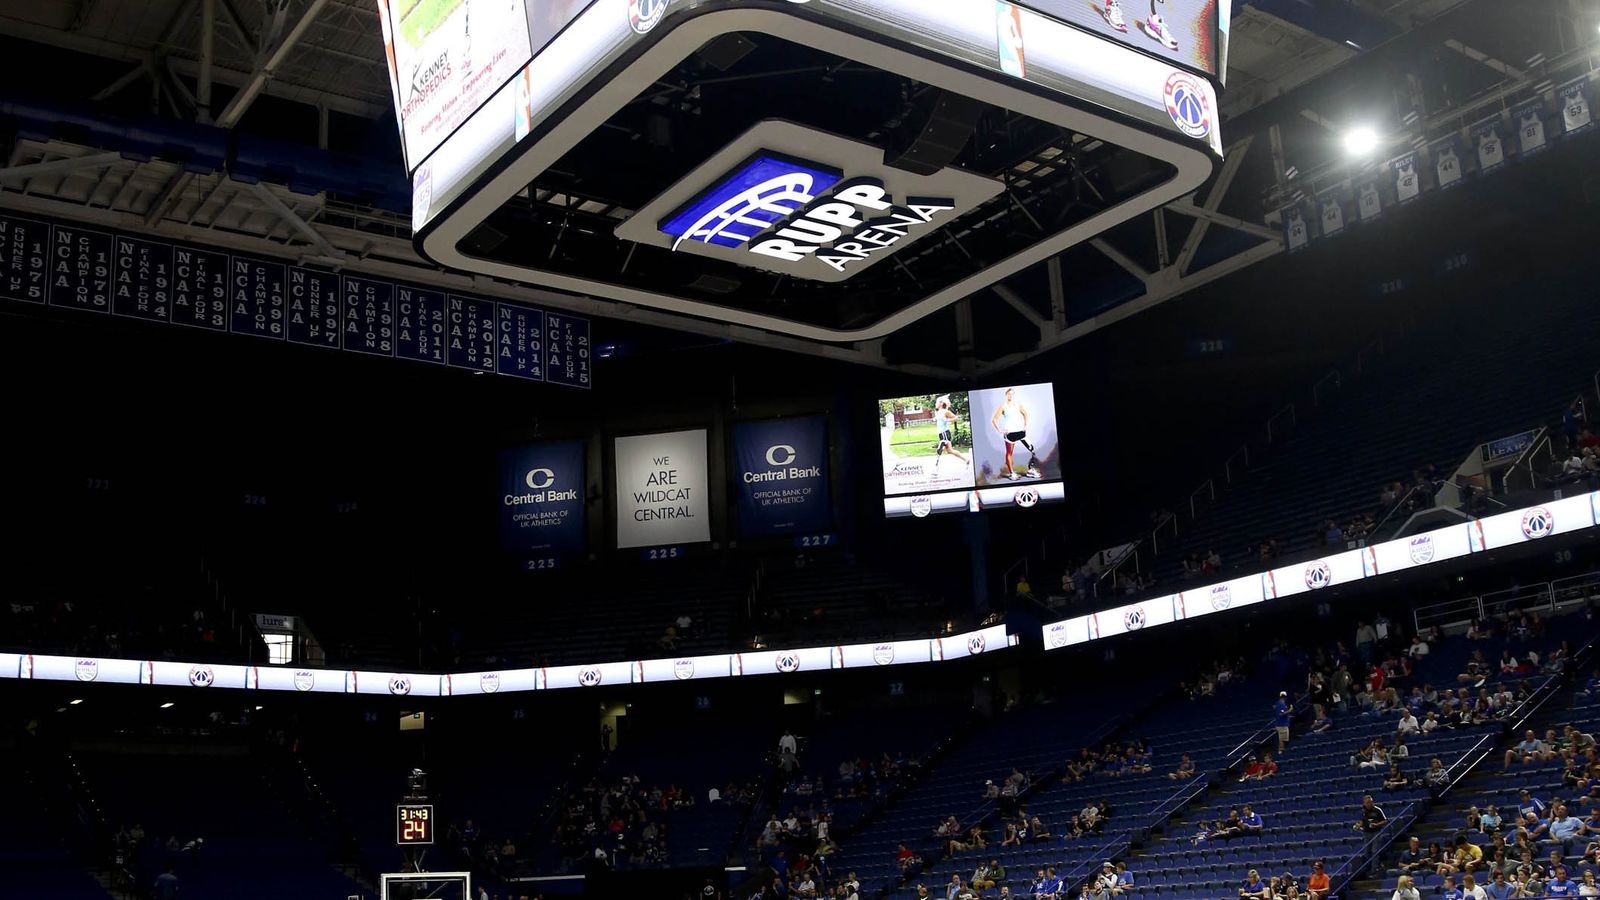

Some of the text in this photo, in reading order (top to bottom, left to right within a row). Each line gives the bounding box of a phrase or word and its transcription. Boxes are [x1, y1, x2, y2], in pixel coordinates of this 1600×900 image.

[401, 62, 452, 120] ORTHOPEDICS
[419, 48, 448, 87] KENNEY
[1570, 105, 1582, 117] 53
[749, 184, 893, 262] RUPP
[815, 204, 956, 272] ARENA
[10, 227, 24, 291] RUNNER UP
[28, 242, 43, 298] 1975
[55, 230, 73, 287] NCAA
[77, 237, 90, 303] CHAMPION
[93, 252, 108, 306] 1978
[118, 242, 135, 297] NCAA
[138, 248, 149, 312] FINAL FOUR
[176, 252, 192, 306] NCAA
[154, 264, 168, 317] 1984
[195, 258, 206, 321] FINAL FOUR
[211, 273, 225, 326] 1993
[235, 261, 249, 315] NCAA
[255, 267, 266, 330] CHAMPION
[270, 282, 283, 334] 1996
[291, 271, 305, 324] NCAA
[309, 278, 320, 338] RUNNER UP
[346, 281, 360, 333] NCAA
[325, 292, 337, 343] 1997
[365, 286, 376, 348] CHAMPION
[380, 301, 392, 352] 1998
[399, 289, 412, 342] NCAA
[418, 296, 428, 355] FINAL FOUR
[431, 310, 443, 360] 2011
[450, 300, 463, 350] NCAA
[467, 305, 478, 363] CHAMPION
[500, 308, 513, 358] NCAA
[549, 316, 561, 366] NCAA
[482, 319, 494, 368] 2012
[518, 314, 527, 370] RUNNER UP
[530, 327, 541, 377] 2014
[565, 323, 575, 379] FINAL FOUR
[578, 336, 590, 384] 2015
[646, 470, 677, 487] ARE
[653, 456, 670, 466] WE
[743, 466, 821, 483] Central Bank
[504, 489, 577, 506] Central Bank
[512, 510, 569, 522] OFFICIAL BANK OF
[633, 488, 691, 503] WILDCAT
[634, 505, 694, 522] CENTRAL.
[753, 487, 812, 499] OFFICIAL BANK OF
[772, 496, 806, 504] ATHLETICS
[531, 518, 561, 527] ATHLETICS
[801, 535, 831, 547] 227
[527, 558, 555, 570] 225
[649, 547, 678, 560] 225
[1554, 550, 1571, 564] 30
[401, 809, 429, 821] 31:43
[403, 820, 425, 840] 24
